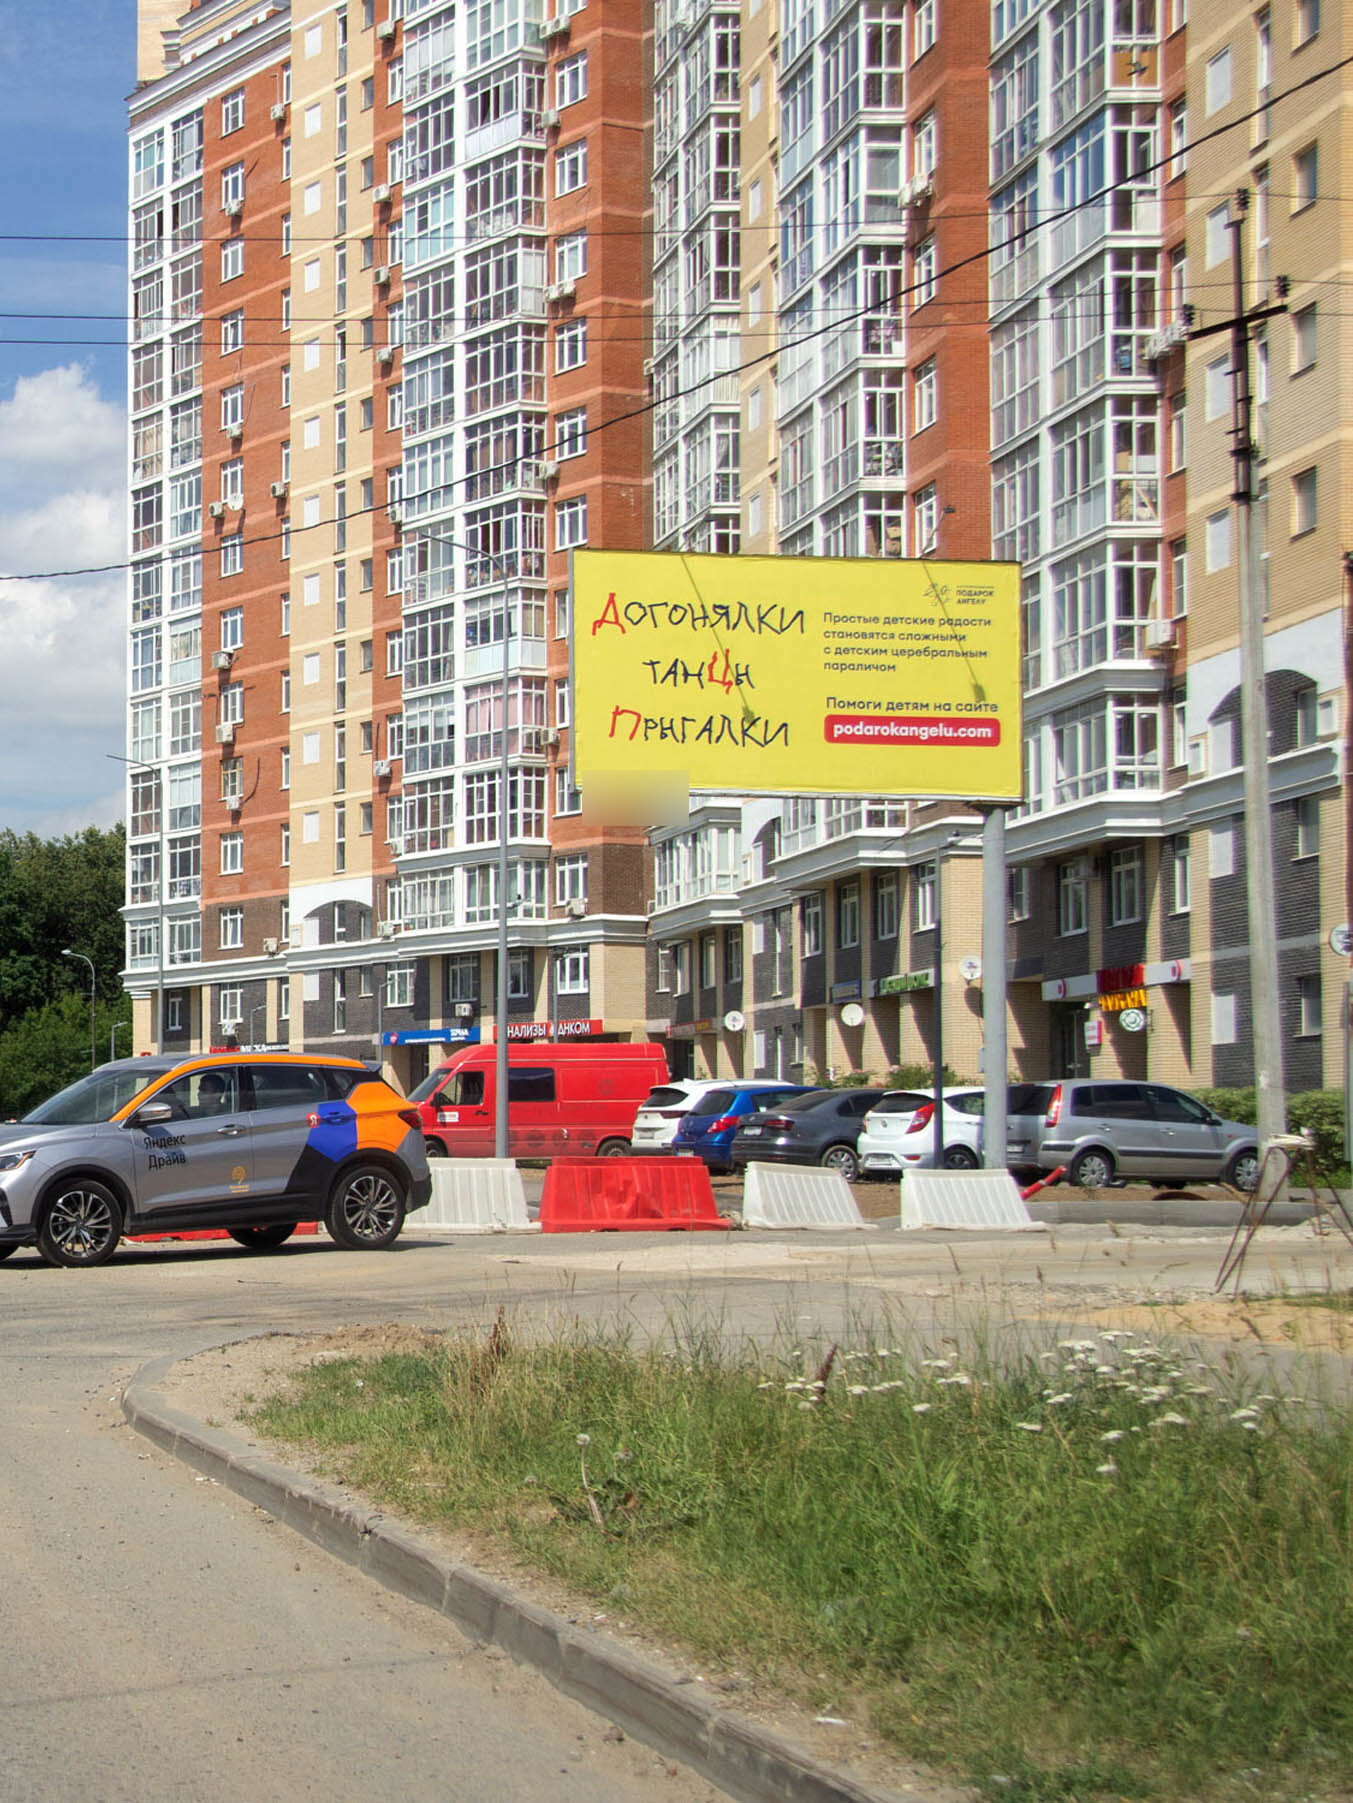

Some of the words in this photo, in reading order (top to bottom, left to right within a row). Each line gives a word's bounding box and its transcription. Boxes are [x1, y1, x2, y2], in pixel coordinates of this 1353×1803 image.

[956, 590, 995, 598] ПОДАРОК
[823, 611, 880, 626] Простые
[882, 614, 936, 626] детские
[938, 617, 992, 628] радости
[823, 630, 896, 641] становятся
[898, 631, 967, 642] сложными
[823, 646, 831, 655] с
[834, 647, 889, 657] детским
[891, 645, 988, 660] церебральным
[823, 661, 897, 673] параличом
[825, 696, 882, 711] Помоги
[885, 700, 930, 712] детям
[933, 702, 952, 712] на
[955, 700, 999, 713] сайте
[832, 720, 993, 741] podarokangelu.com
[506, 1023, 546, 1038] НАЛИЗЫ
[143, 1134, 187, 1150] Яндекс
[148, 1151, 188, 1171] Драйв
